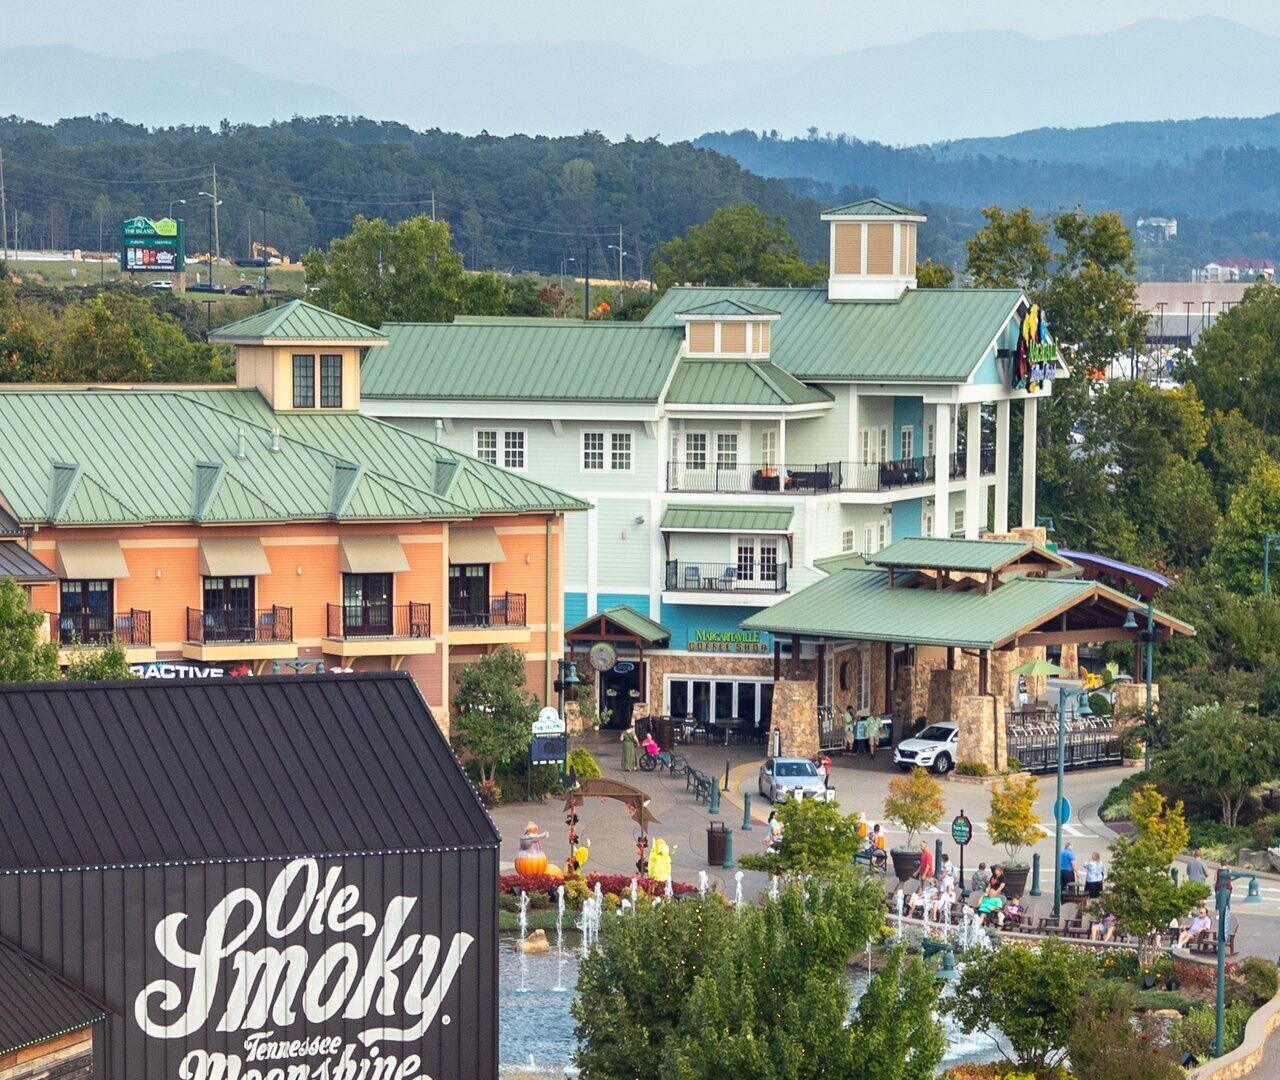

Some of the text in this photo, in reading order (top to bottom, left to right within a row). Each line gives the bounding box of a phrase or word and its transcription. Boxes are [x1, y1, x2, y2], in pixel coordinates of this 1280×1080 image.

[695, 629, 760, 643] MARGARITAVILLE
[266, 857, 377, 938] Ole
[244, 1031, 343, 1063] Tennessee
